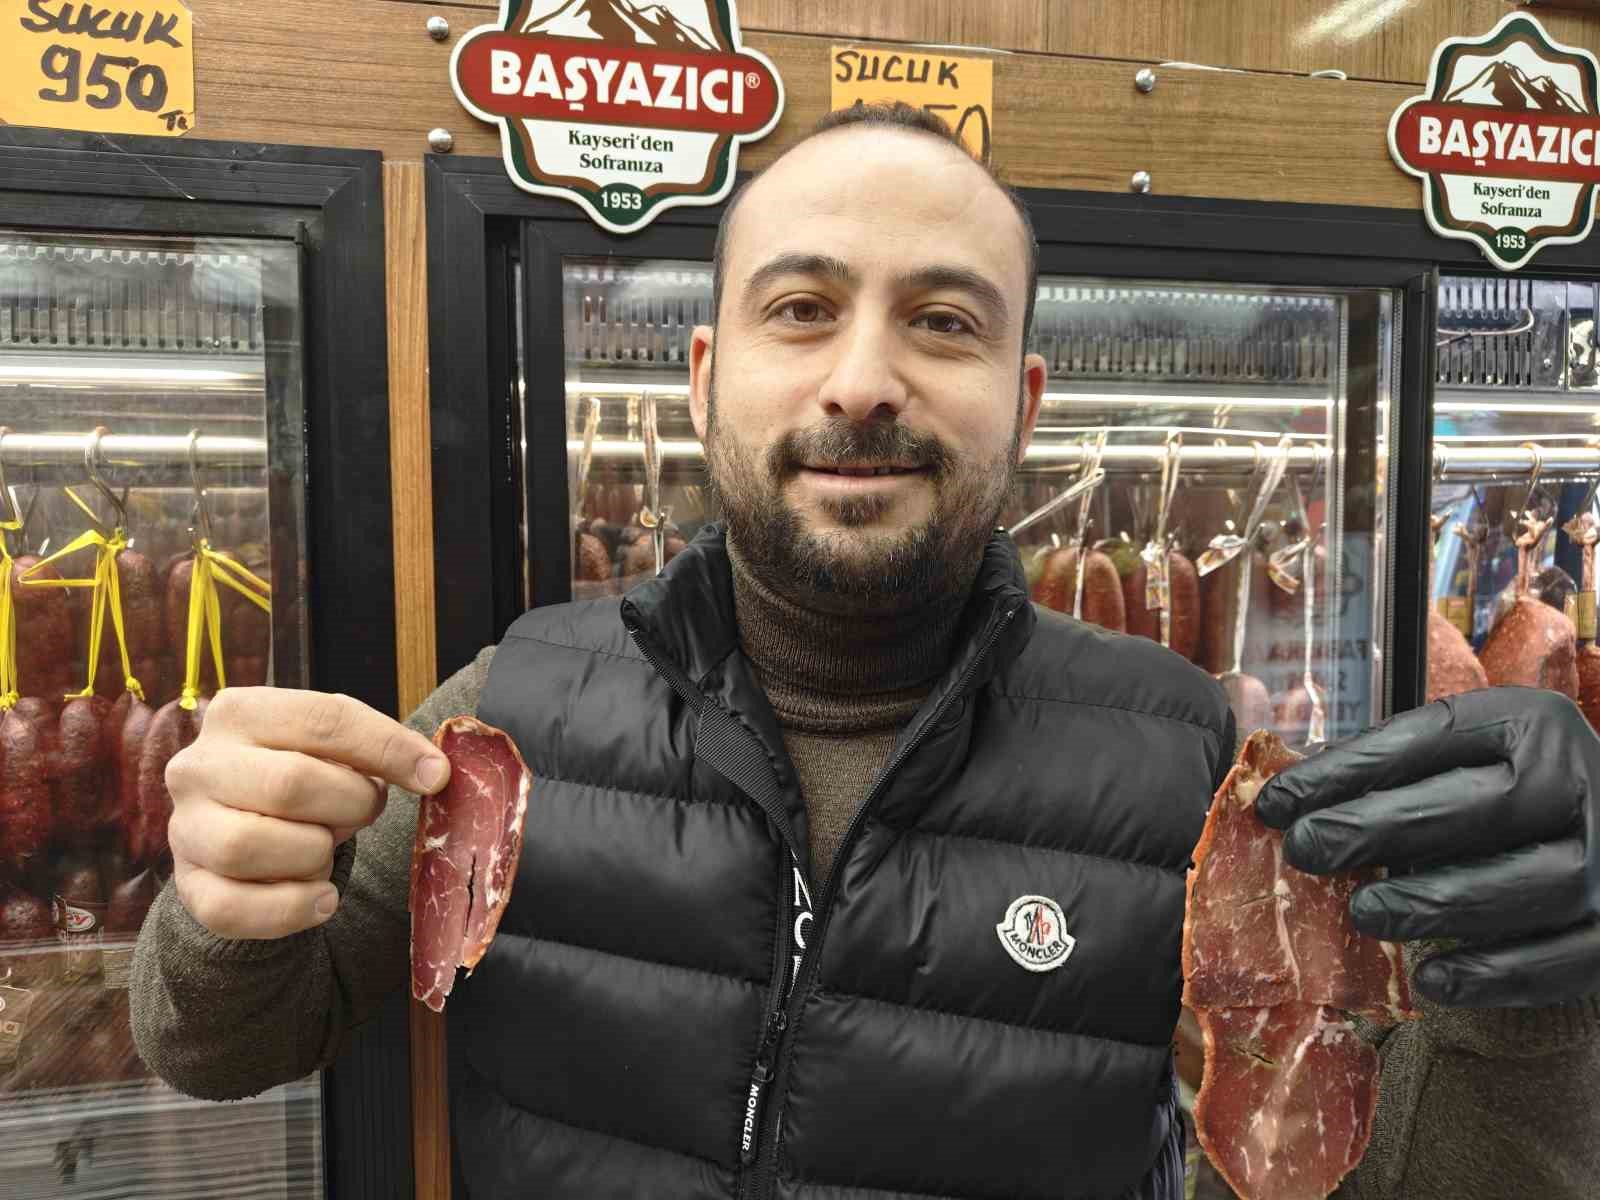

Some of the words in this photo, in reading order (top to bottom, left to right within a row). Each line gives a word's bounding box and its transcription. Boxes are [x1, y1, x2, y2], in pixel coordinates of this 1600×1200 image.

[38, 44, 168, 112] 950
[835, 50, 960, 89] SUCUK
[568, 130, 674, 153] Kayseri'den
[579, 153, 664, 174] Sofranıza
[601, 191, 642, 210] 1953
[1473, 182, 1550, 200] Kayseri'den
[1496, 234, 1526, 249] 1953
[1010, 933, 1063, 959] MONCLER
[742, 1084, 760, 1151] MONCLER
